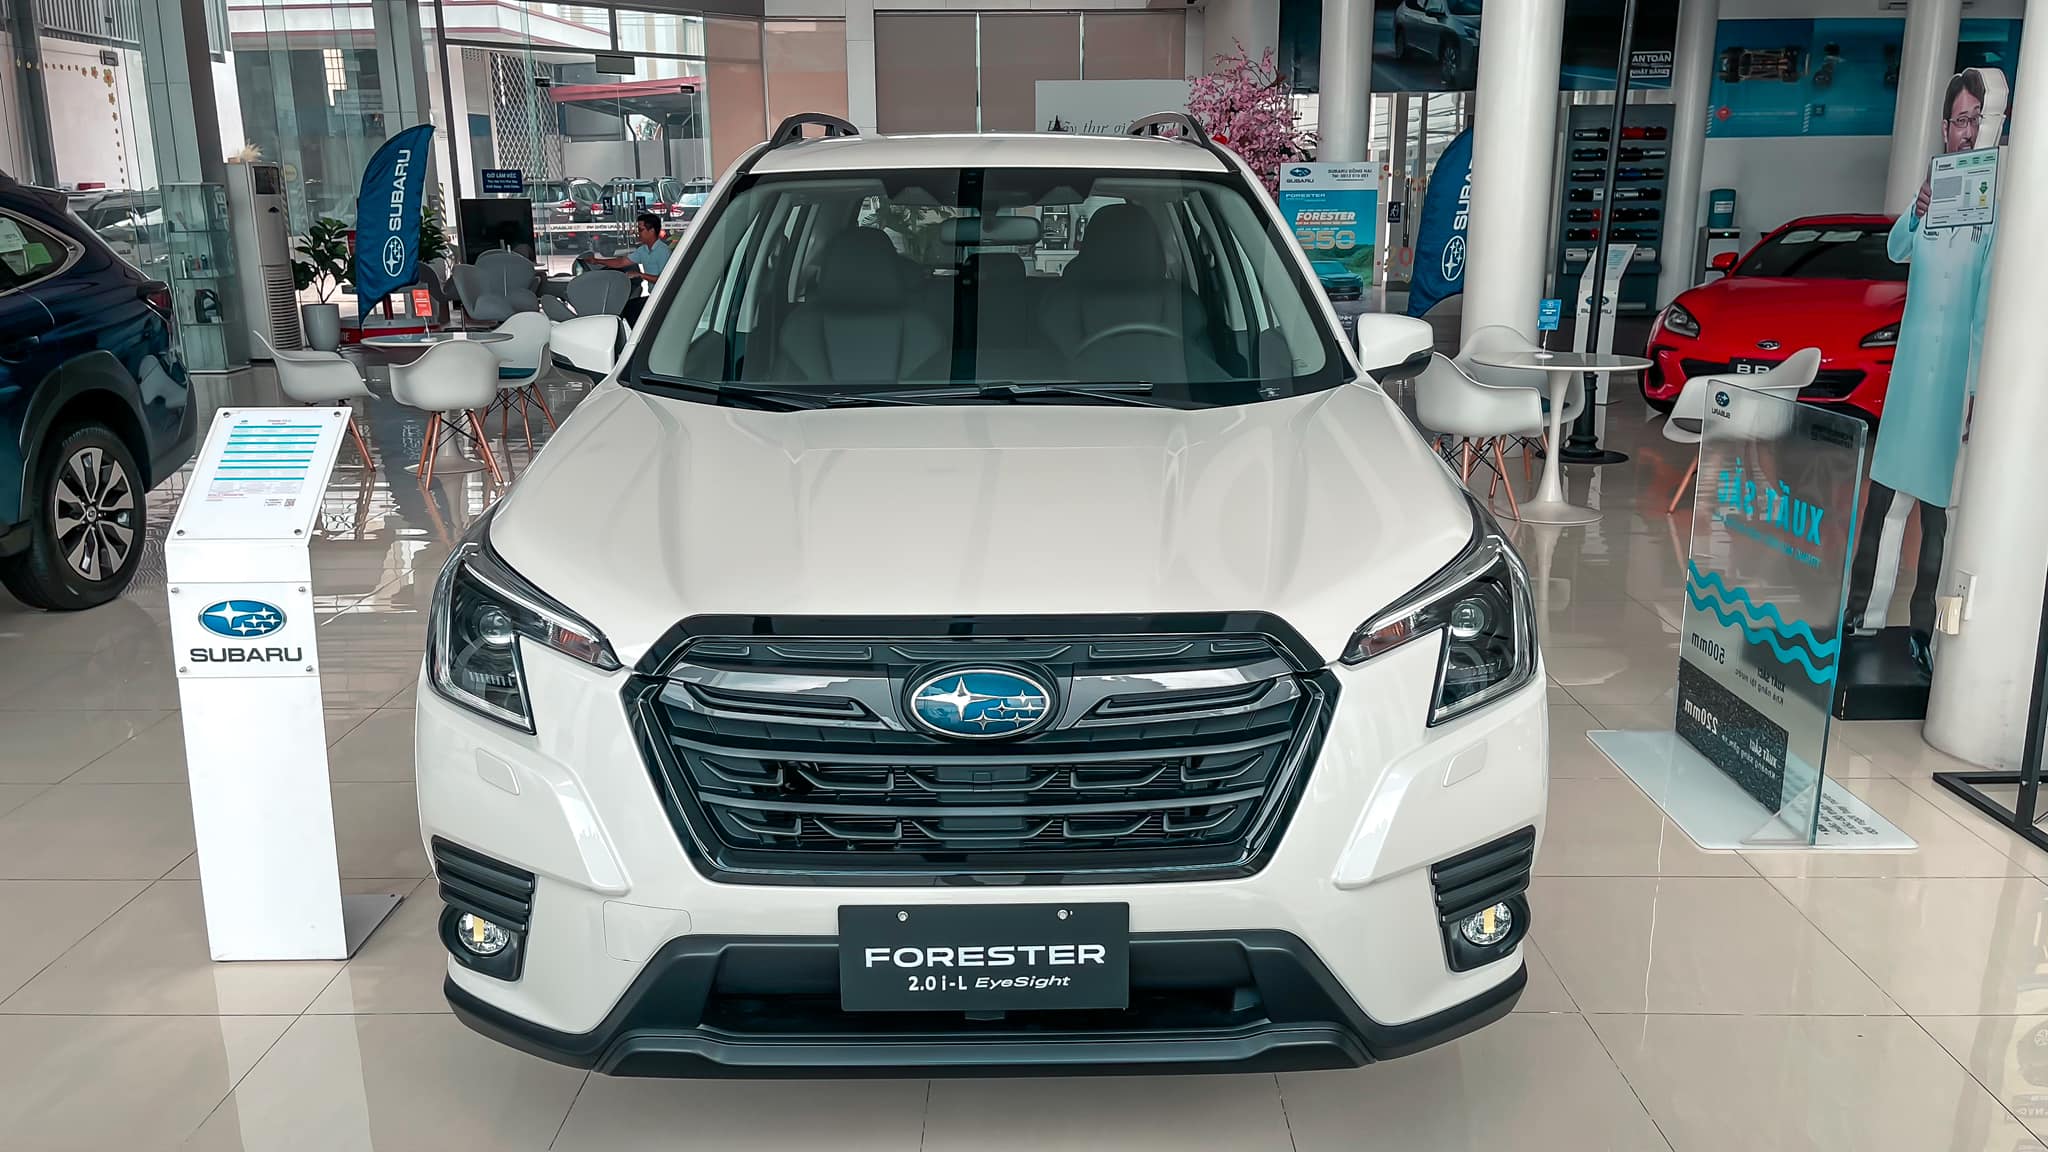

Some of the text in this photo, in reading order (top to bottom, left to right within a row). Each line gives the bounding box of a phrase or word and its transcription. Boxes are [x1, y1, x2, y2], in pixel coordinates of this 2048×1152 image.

[389, 149, 411, 231] SUBARU
[1453, 159, 1472, 230] SUBA
[1296, 212, 1356, 221] FORESTER
[1296, 230, 1356, 250] 250
[1736, 364, 1770, 374] BR
[190, 647, 303, 662] SUBARU
[864, 944, 1106, 968] FORESTER
[974, 975, 1071, 990] EyeSight
